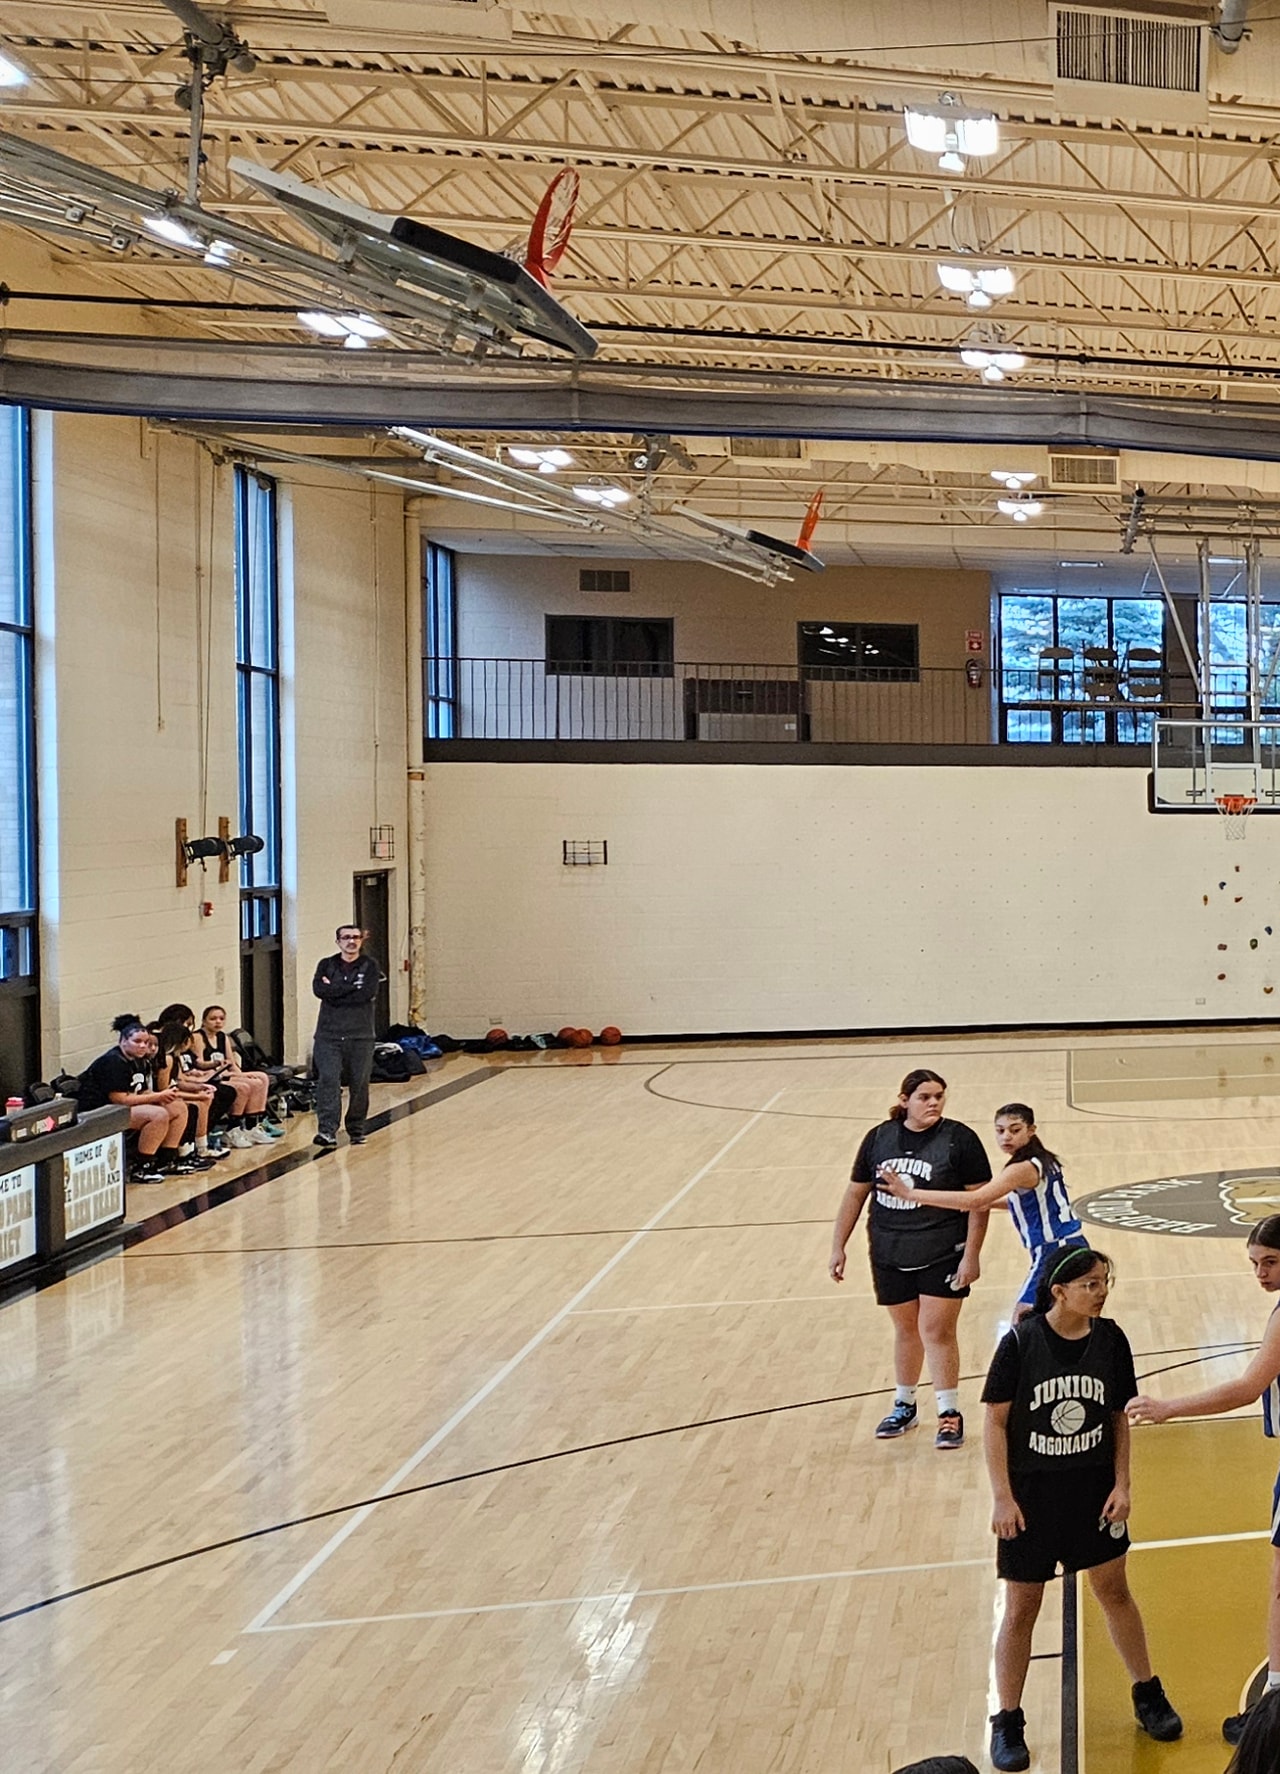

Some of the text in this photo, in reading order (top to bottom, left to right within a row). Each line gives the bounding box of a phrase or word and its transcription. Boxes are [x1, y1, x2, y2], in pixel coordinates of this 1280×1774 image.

[12, 1174, 22, 1190] TO
[107, 1170, 120, 1186] AND
[1087, 1200, 1217, 1233] BEDFORD
[1029, 1375, 1105, 1411] JUNIOR
